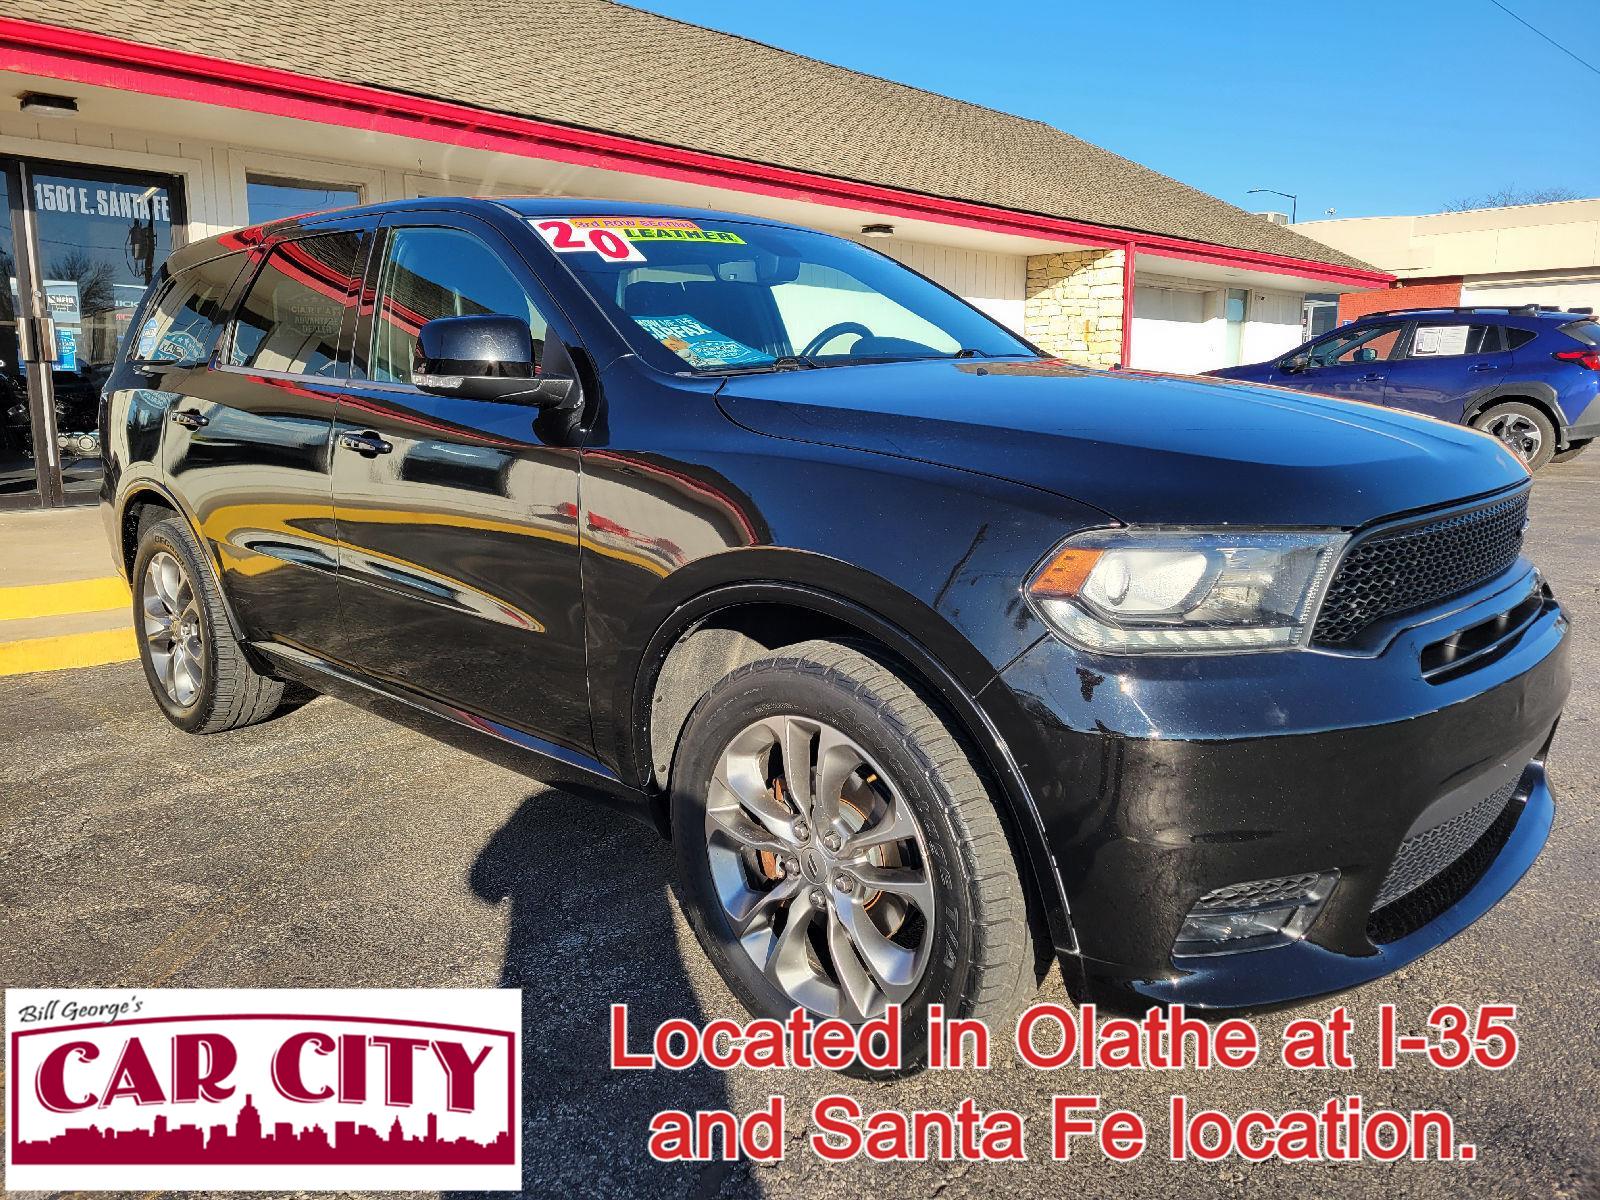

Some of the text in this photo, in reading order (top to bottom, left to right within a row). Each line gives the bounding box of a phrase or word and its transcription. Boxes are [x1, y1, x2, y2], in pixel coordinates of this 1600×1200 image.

[34, 183, 171, 222] 1501 E. SANTA FE
[575, 220, 600, 229] 3rd
[603, 219, 636, 228] ROW
[623, 227, 734, 241] LEATHER
